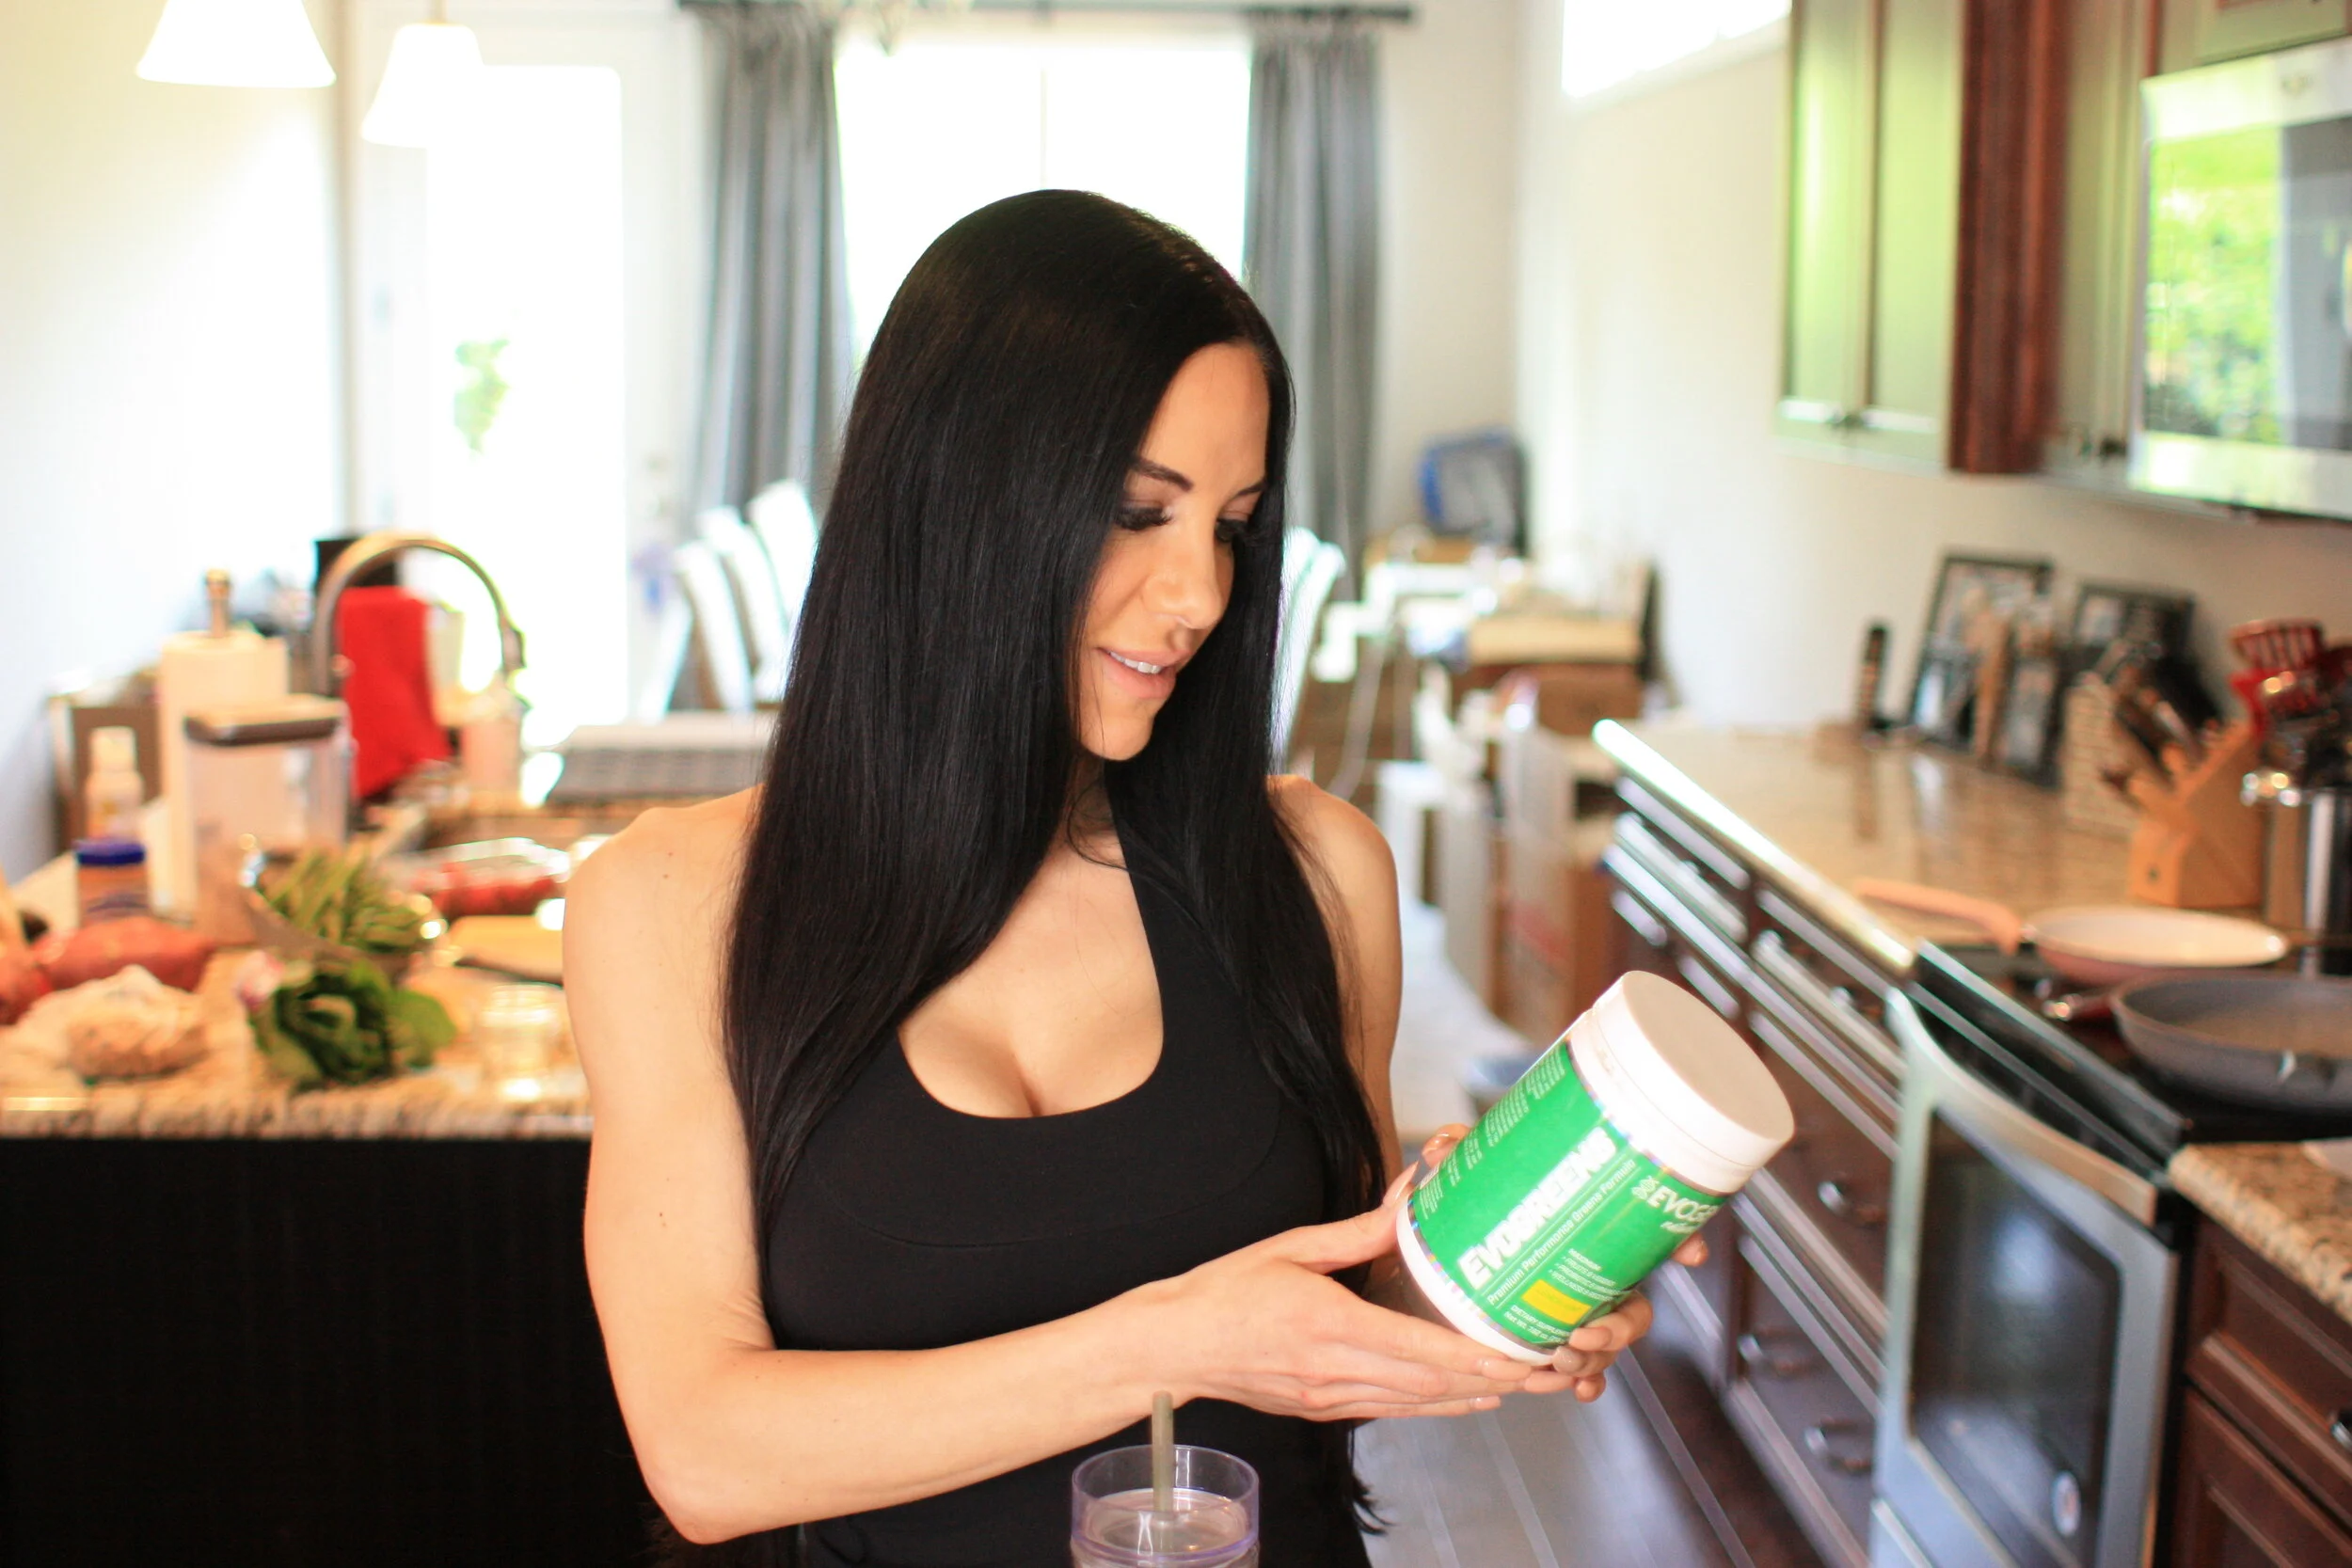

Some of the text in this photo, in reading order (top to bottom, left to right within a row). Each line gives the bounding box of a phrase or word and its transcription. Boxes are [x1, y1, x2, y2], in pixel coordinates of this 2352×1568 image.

[1457, 1126, 1616, 1290] EVOGREENS
[1486, 1266, 1526, 1307] Premium
[1520, 1216, 1576, 1273] Performance
[1569, 1188, 1604, 1223] Greens
[1597, 1155, 1637, 1195] Formula
